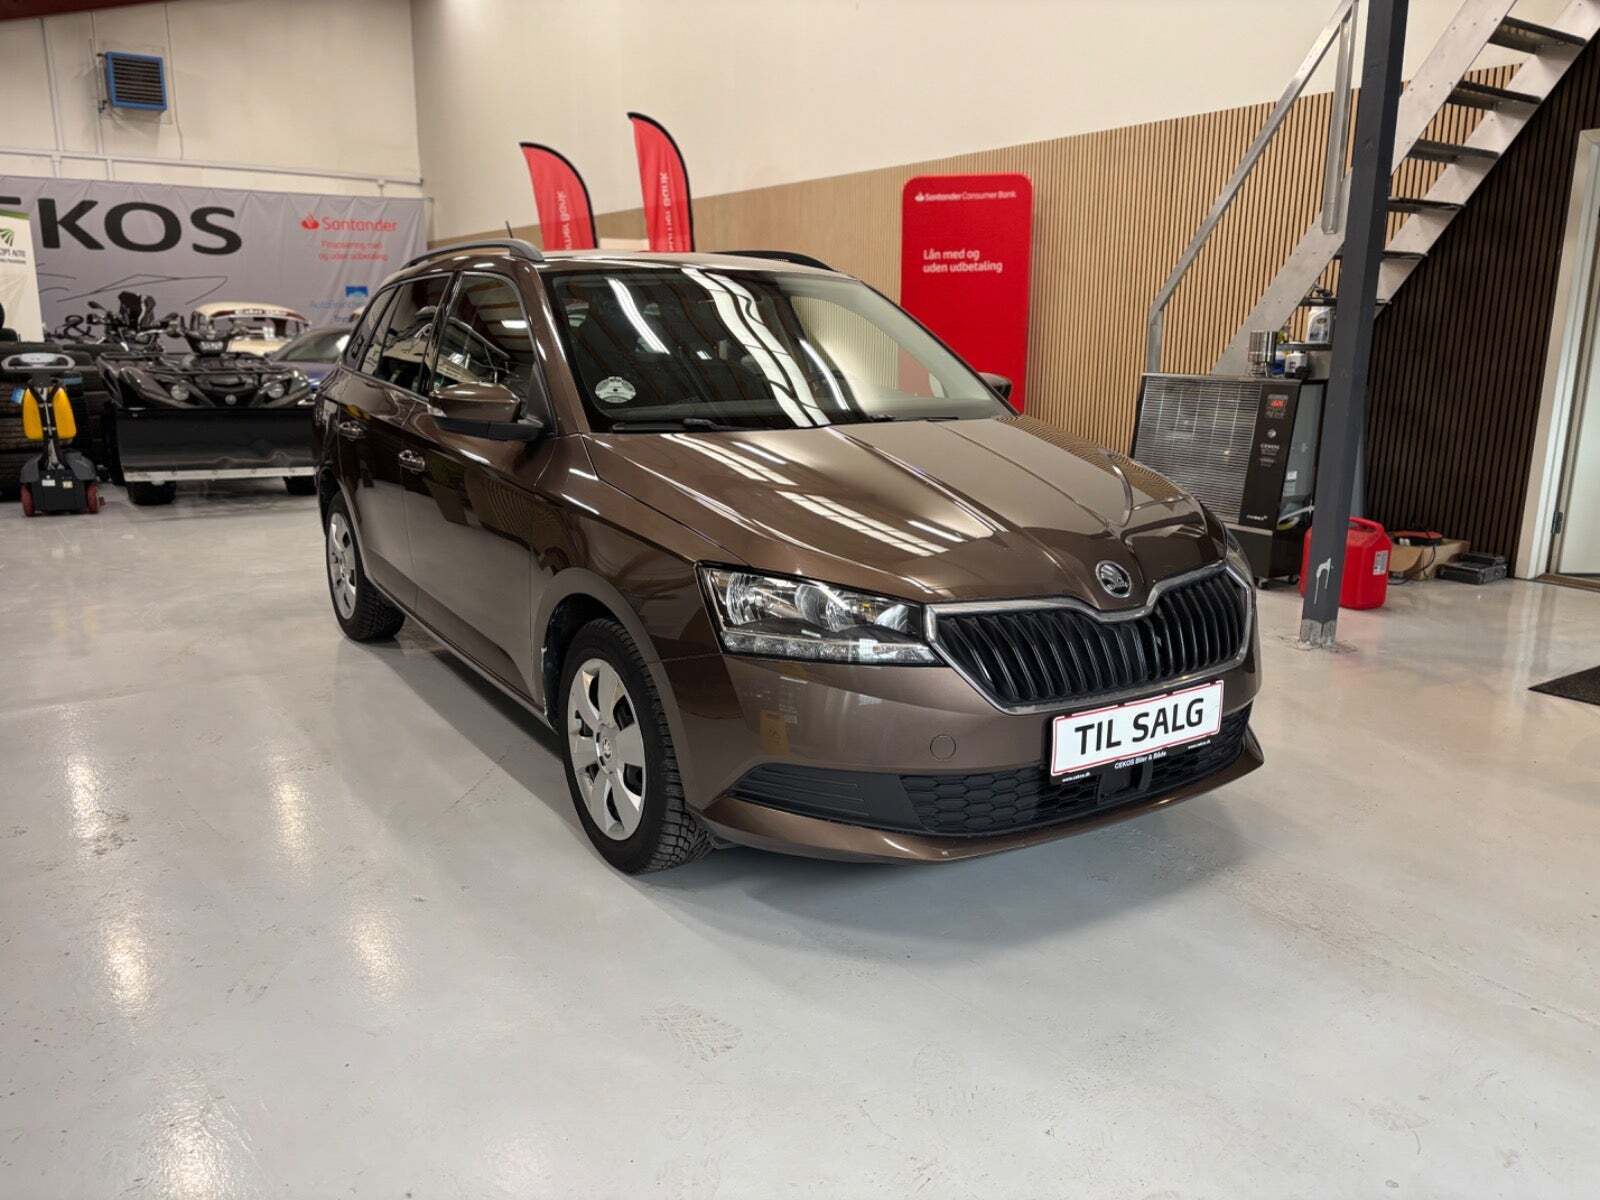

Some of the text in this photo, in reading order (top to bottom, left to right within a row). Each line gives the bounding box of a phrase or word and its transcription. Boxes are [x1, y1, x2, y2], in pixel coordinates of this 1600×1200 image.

[0, 196, 243, 255] KOS
[321, 216, 398, 232] Santander
[923, 248, 980, 261] Lån med og
[923, 261, 1003, 274] uden udbetaling
[1074, 698, 1204, 755] TIL SALG
